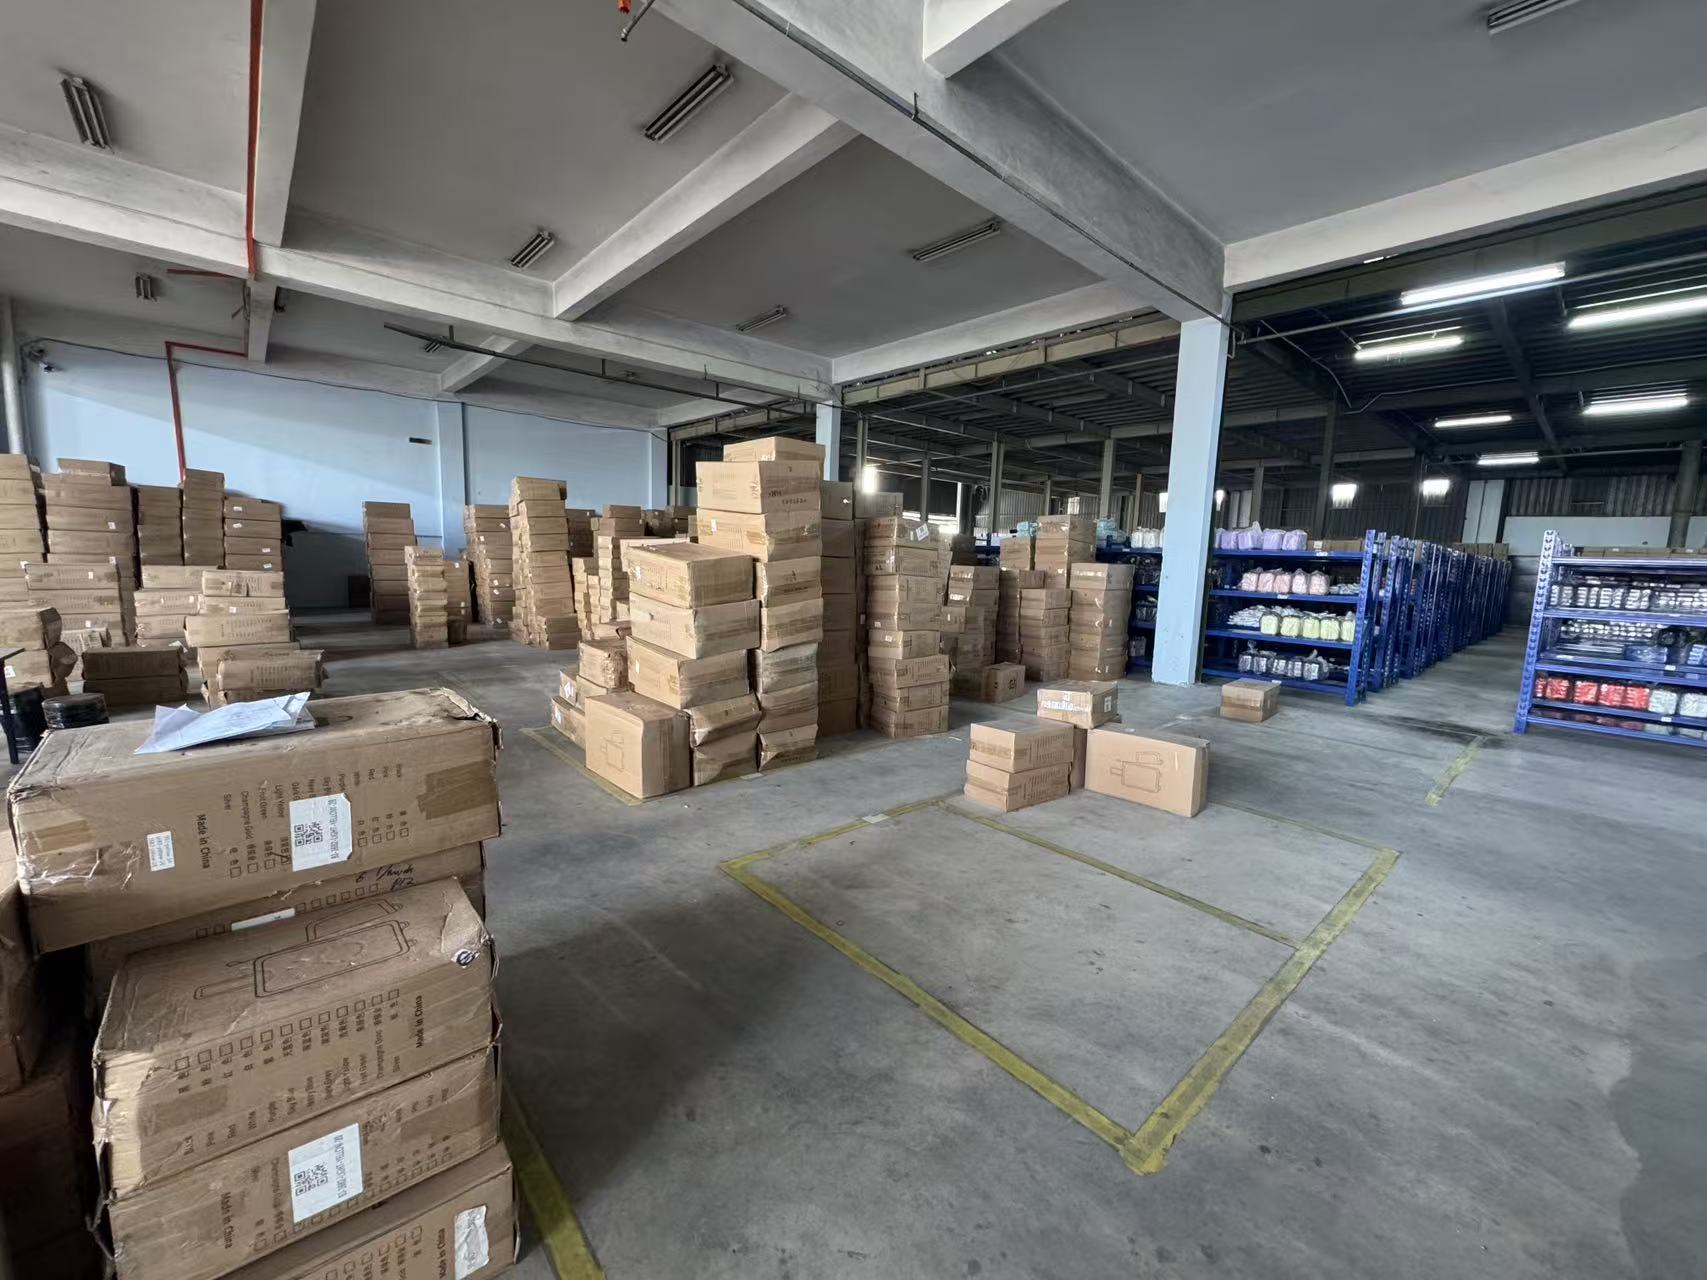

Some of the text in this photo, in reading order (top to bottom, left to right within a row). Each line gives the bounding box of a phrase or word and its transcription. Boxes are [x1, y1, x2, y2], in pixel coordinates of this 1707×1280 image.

[196, 814, 212, 869] Made in China
[413, 995, 424, 1017] China
[415, 1029, 425, 1048] Made
[221, 1192, 231, 1211] Made
[224, 1226, 234, 1249] China
[437, 1228, 446, 1249] China
